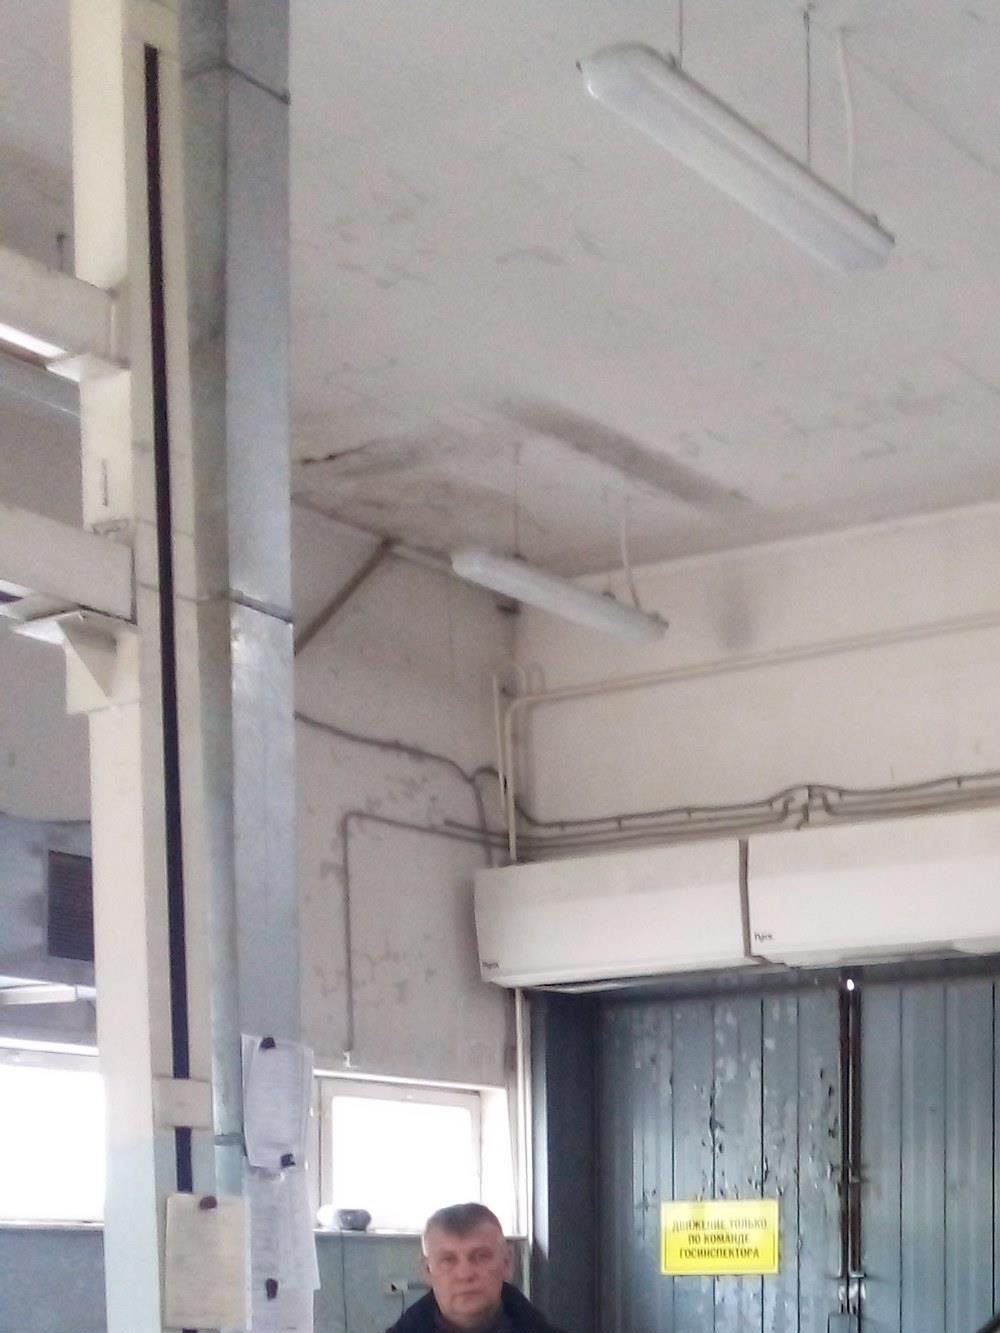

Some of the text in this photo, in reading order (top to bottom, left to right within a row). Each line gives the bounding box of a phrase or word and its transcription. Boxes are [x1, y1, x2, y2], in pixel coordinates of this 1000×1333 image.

[688, 1233, 750, 1245] ПО КОМАНДЕ
[679, 1246, 760, 1259] ГОСИНСПЕКТОРА
